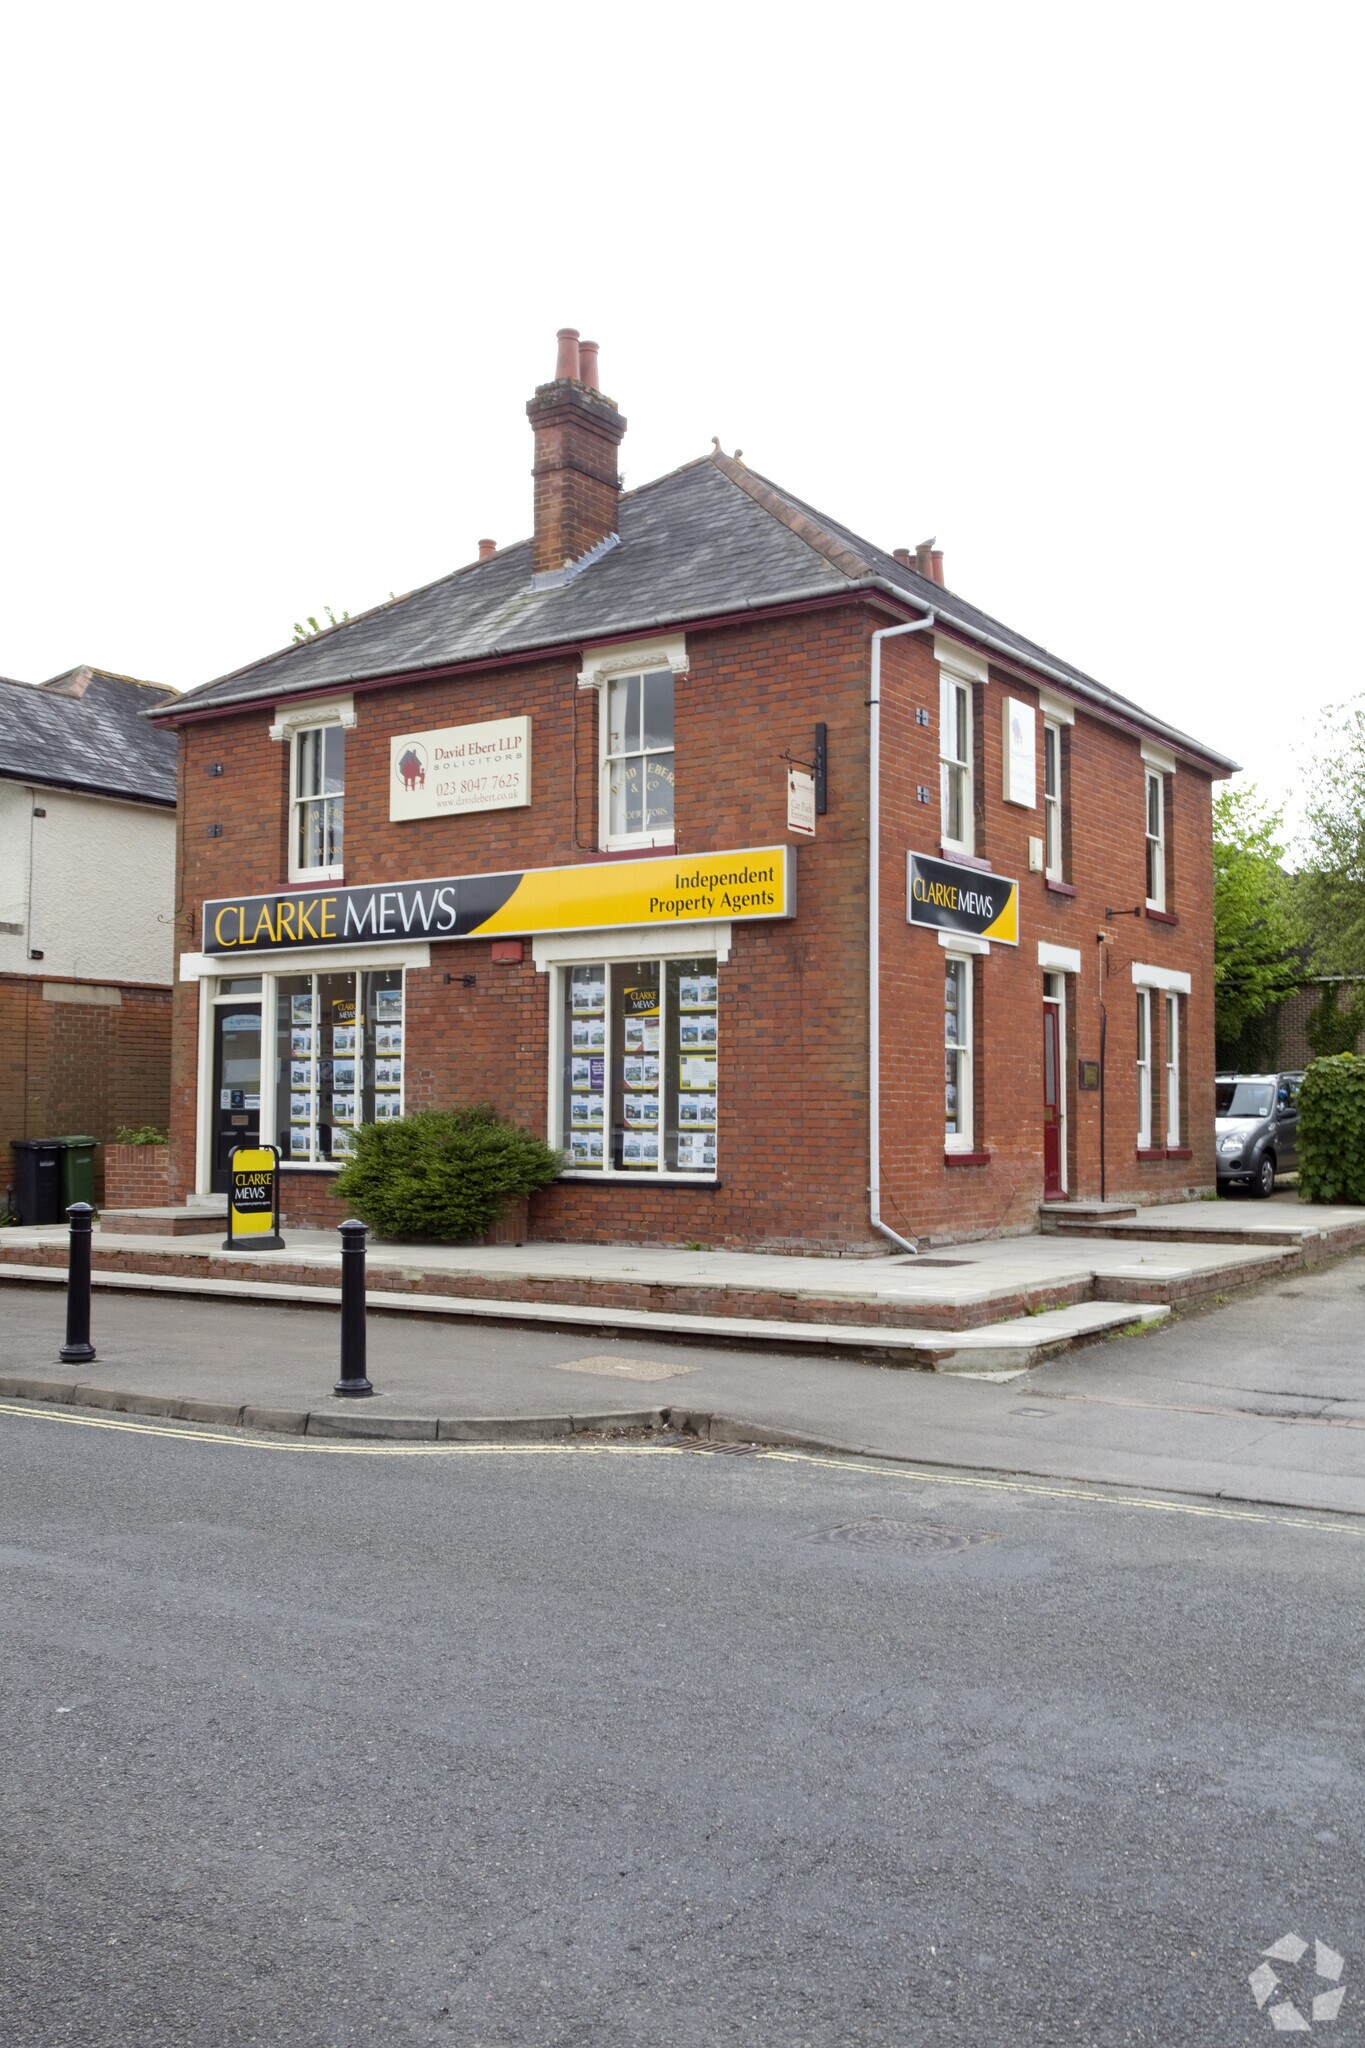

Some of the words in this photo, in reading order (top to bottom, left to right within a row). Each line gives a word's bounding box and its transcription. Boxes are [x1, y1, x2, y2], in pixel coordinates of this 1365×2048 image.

[434, 744, 465, 760] David
[468, 741, 496, 756] Ebert
[499, 736, 522, 751] LLP
[433, 752, 523, 771] SOLICITORS
[436, 781, 456, 797] 023
[461, 777, 487, 793] 8047
[492, 773, 519, 789] 7625
[630, 783, 639, 793] &
[436, 788, 519, 808] www.davidebert.co.uk
[675, 866, 774, 892] Independent
[649, 894, 716, 917] Property
[720, 890, 774, 913] Agents
[912, 877, 957, 910] CLARKE
[957, 888, 993, 919] MEWS
[214, 897, 337, 947] CLARKE
[343, 886, 457, 937] MEWS
[630, 991, 657, 1000] CLARKE
[632, 1000, 655, 1009] MEWS
[235, 1173, 272, 1187] CLARKE
[234, 1186, 265, 1200] MEWS
